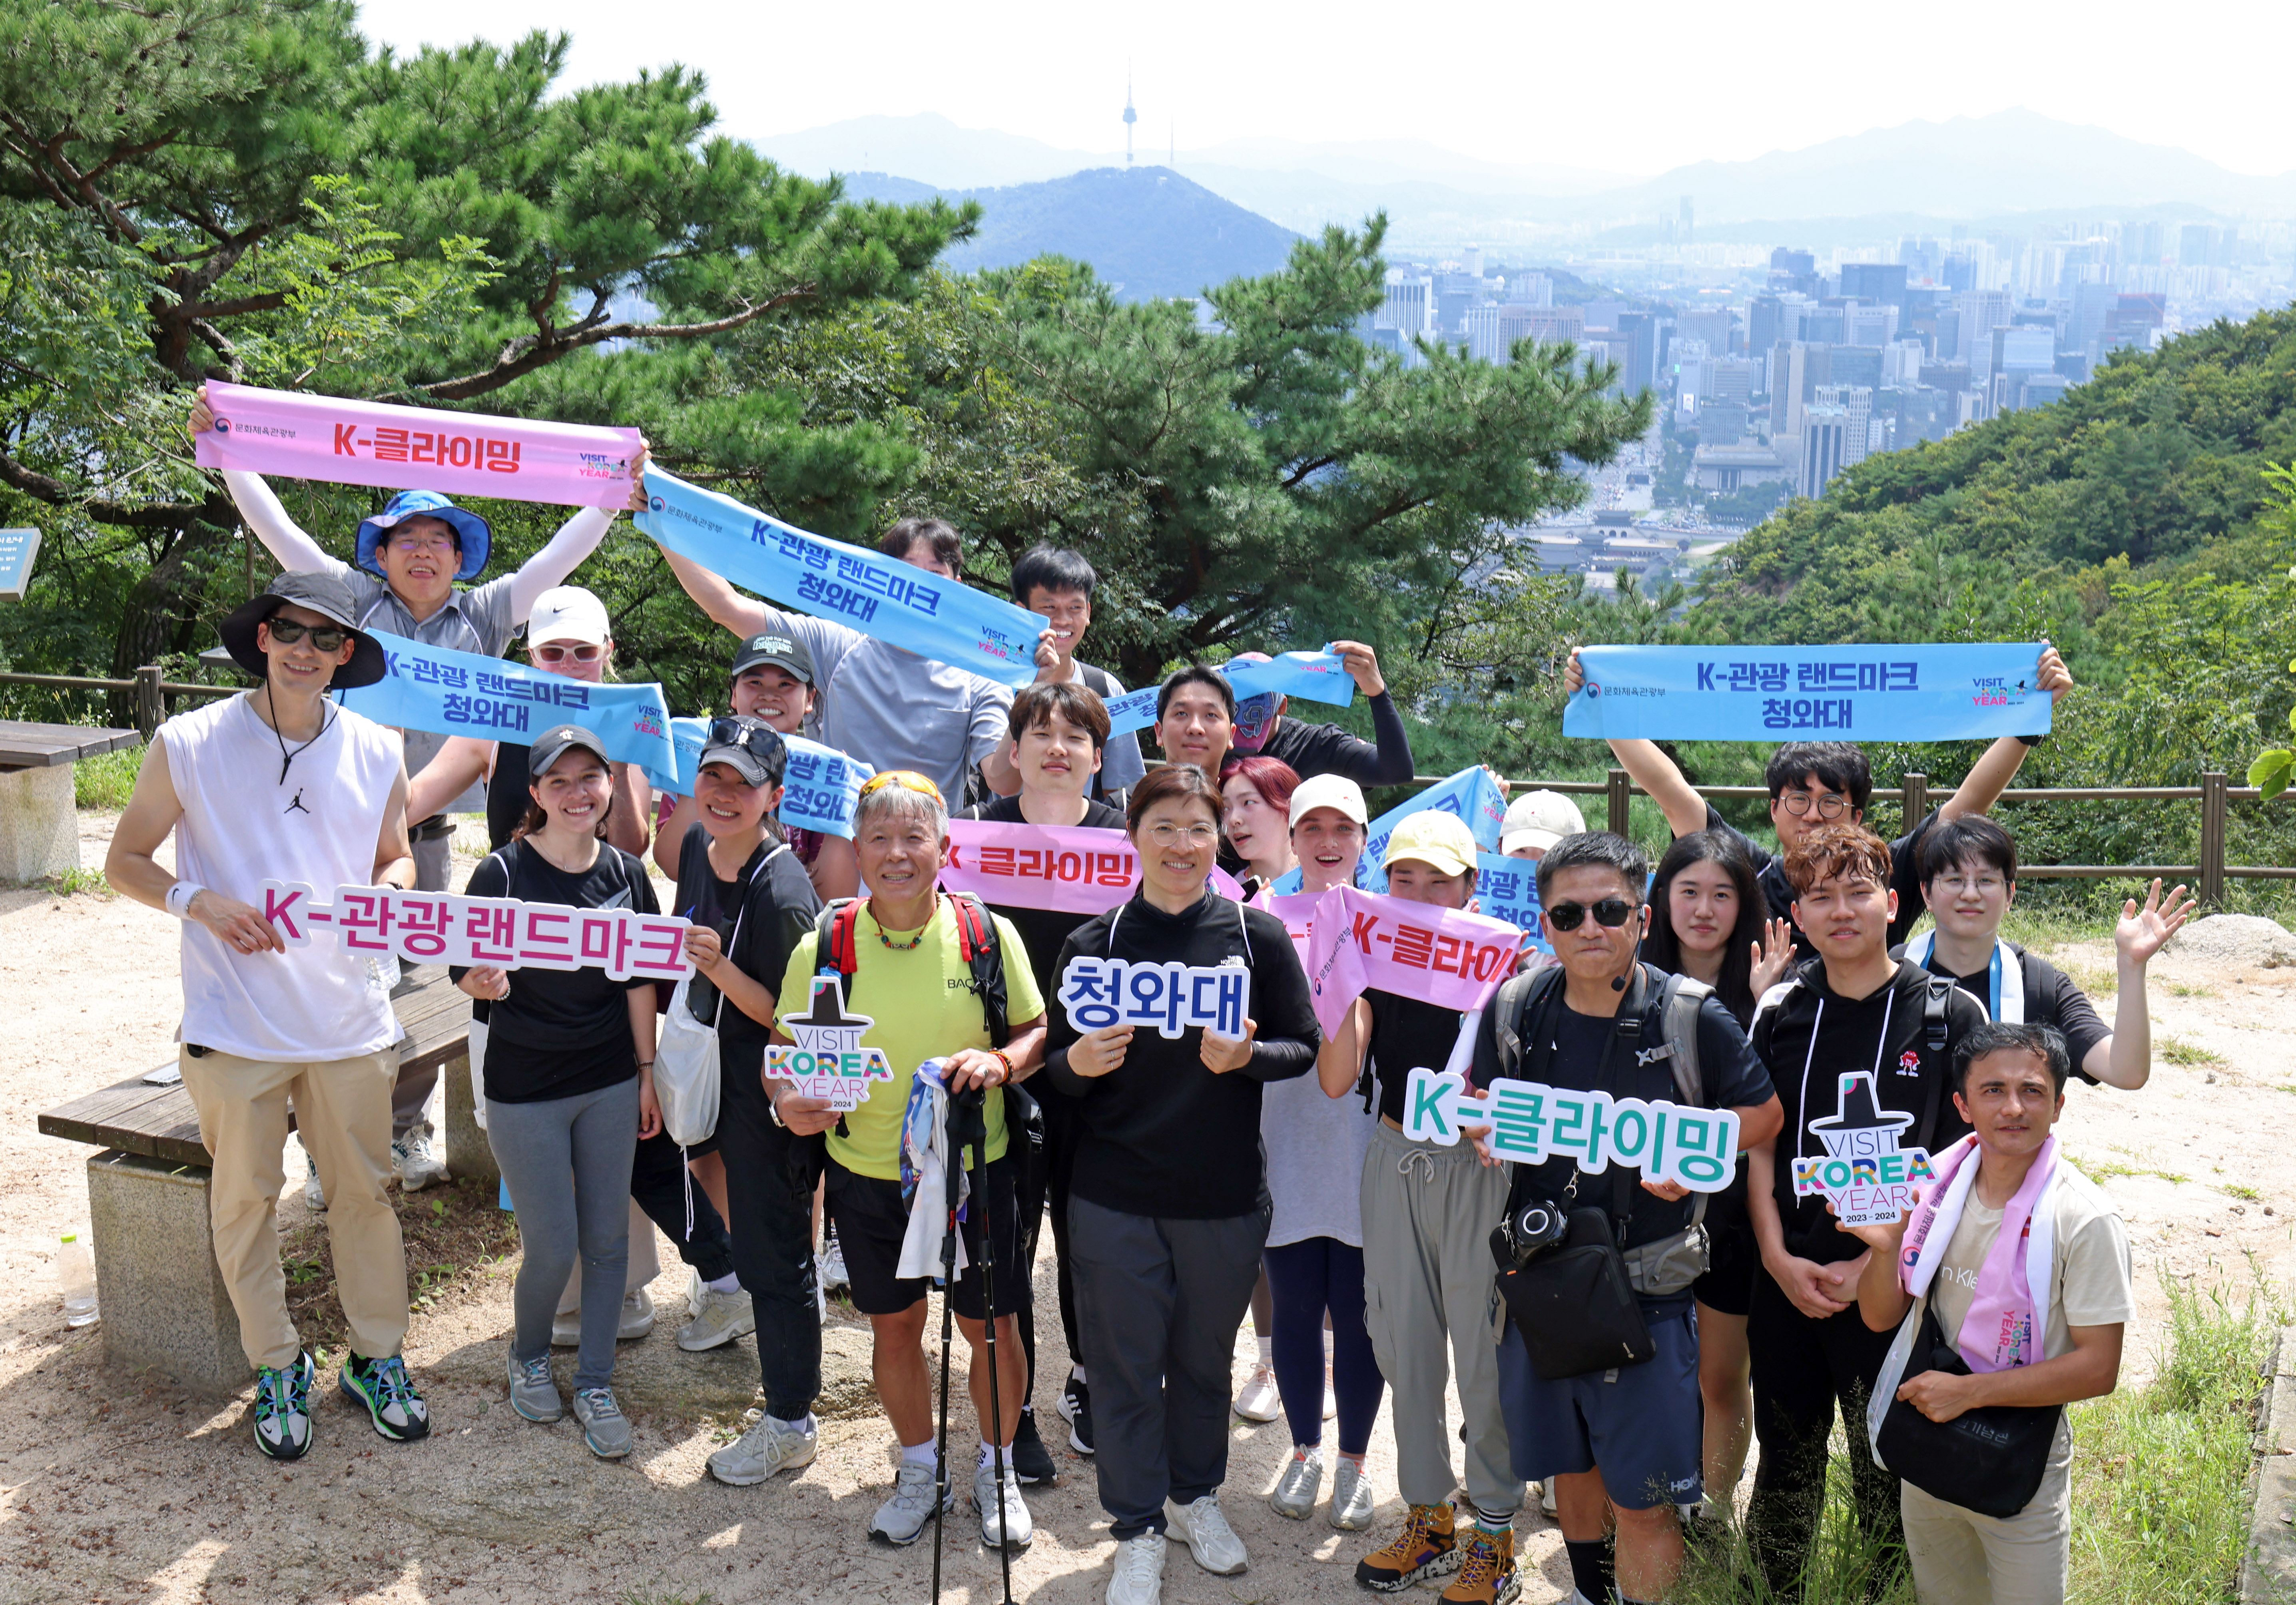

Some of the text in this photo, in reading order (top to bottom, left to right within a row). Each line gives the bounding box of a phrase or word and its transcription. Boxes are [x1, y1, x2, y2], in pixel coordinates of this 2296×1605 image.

[235, 424, 296, 439] 문화체육관광부
[335, 423, 520, 474] K-클라이밍
[580, 452, 607, 462] VISIT
[579, 468, 609, 479] YEAR
[668, 505, 722, 534] 문화체육관광부
[751, 520, 941, 617] K-관광 랜드마크
[797, 572, 879, 623] 청와대
[982, 625, 1008, 643] VISIT
[979, 641, 1006, 659] YEAR
[385, 650, 590, 710] K-관광 랜드마크
[1697, 662, 1919, 692] K-관광 랜드마크
[1973, 678, 2004, 687] VISIT
[1604, 686, 1666, 697] 문화체육관광부
[1972, 696, 2007, 706] YEAR
[443, 694, 529, 732] 청와대
[638, 705, 663, 718] VISIT
[1762, 699, 1852, 729] 청와대
[634, 722, 660, 737] YEAR
[265, 889, 687, 972] K-관광 랜드마크
[1067, 965, 1242, 1035] 청와대
[795, 1029, 861, 1051] VISIT
[769, 1051, 889, 1078] KOREA
[795, 1078, 865, 1098] YEAR
[1412, 1079, 1729, 1182] K-클라이밍
[1825, 1129, 1900, 1158] VISIT
[1797, 1154, 1936, 1191] KOREA
[1828, 1185, 1910, 1212] YEAR
[1846, 1214, 1867, 1223] 2023
[1875, 1211, 1895, 1220] 2024
[1999, 1310, 2015, 1346] YEAR
